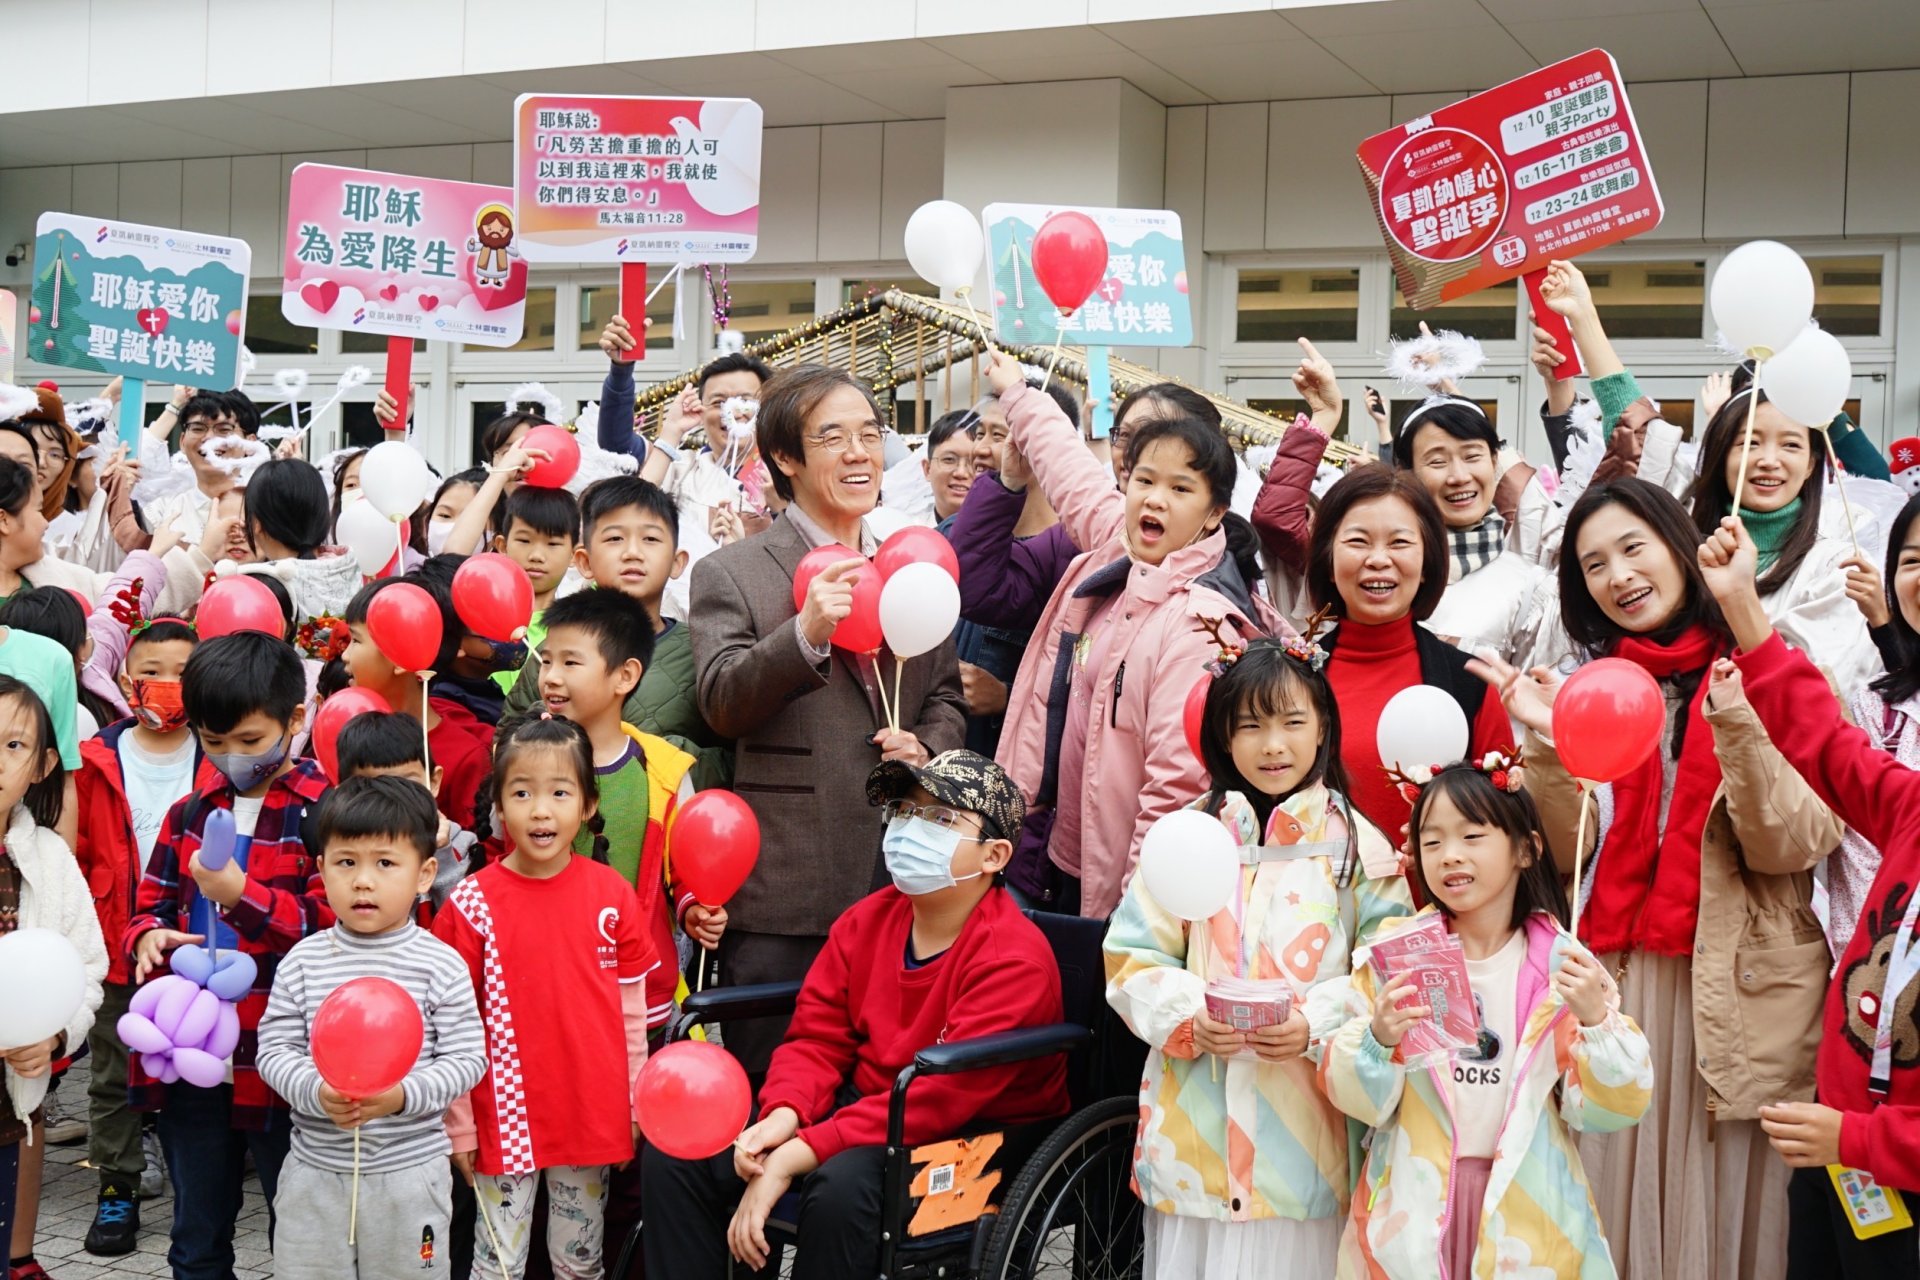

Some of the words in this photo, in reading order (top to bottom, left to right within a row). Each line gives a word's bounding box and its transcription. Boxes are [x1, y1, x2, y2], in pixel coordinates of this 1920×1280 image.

[1550, 85, 1608, 119] 聖誕雙語
[1545, 105, 1611, 138] 親子Party
[538, 135, 719, 157] 「凡勞苦擔重擔的人可
[1579, 135, 1622, 163] 音樂會
[539, 186, 657, 205] 你們得安息。」
[1391, 162, 1498, 223] 夏凱納暖心
[1591, 171, 1634, 199] 歌舞劇
[342, 183, 422, 227] 耶穌
[600, 212, 683, 225] 馬太福音11:28
[1410, 192, 1499, 252] 聖誕季
[297, 225, 457, 278] 為愛降生
[1105, 254, 1167, 287] 愛你
[90, 272, 220, 323] 耶穌愛你
[87, 324, 216, 376] 聖誕快樂
